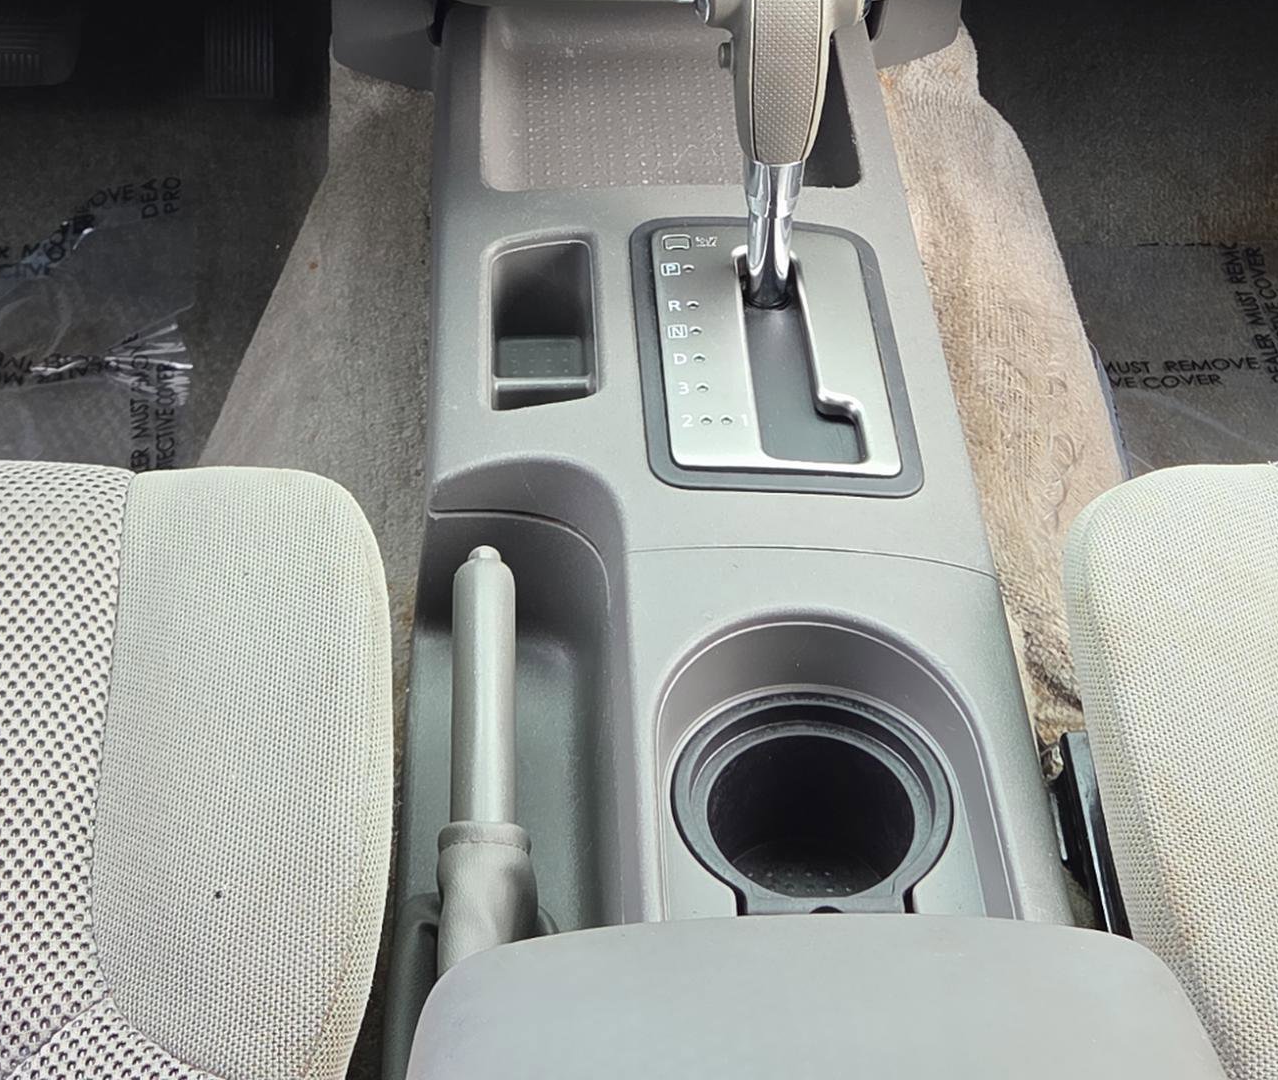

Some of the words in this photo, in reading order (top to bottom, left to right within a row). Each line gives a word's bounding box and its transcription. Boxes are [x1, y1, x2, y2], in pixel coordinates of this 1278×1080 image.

[668, 300, 681, 312] R
[673, 353, 687, 365] D
[1161, 356, 1262, 372] REMOVE
[1142, 373, 1224, 390] COVER
[678, 382, 690, 395] 3
[681, 414, 694, 427] 2
